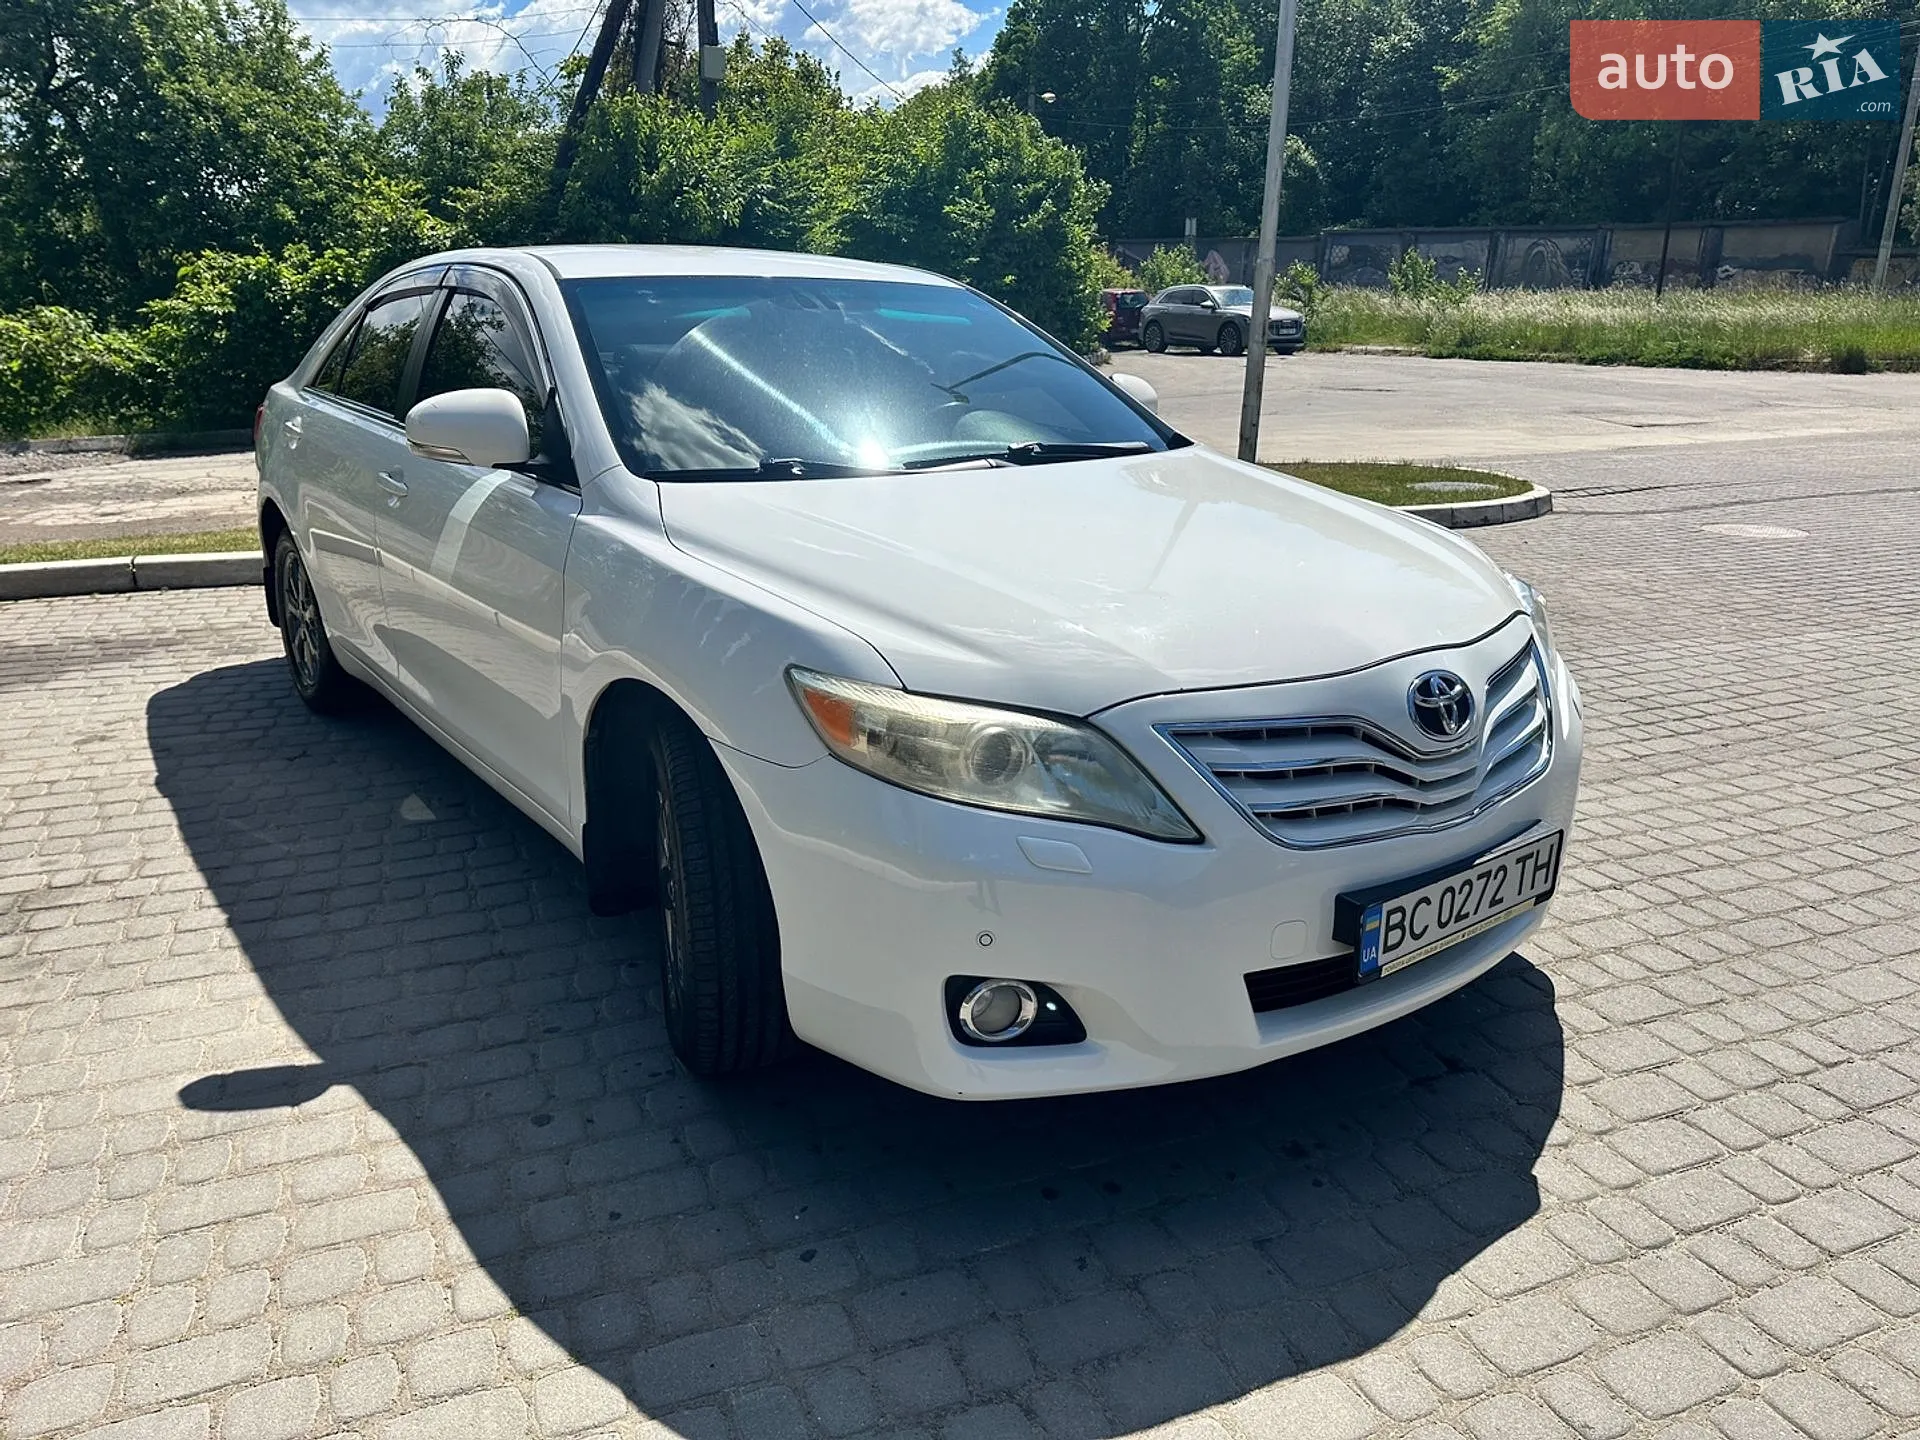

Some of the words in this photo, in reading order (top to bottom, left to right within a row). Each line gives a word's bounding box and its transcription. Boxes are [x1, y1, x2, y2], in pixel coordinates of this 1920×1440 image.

[1383, 895, 1432, 954] BC
[1437, 864, 1508, 930] 0272
[1516, 844, 1555, 896] TH
[1362, 945, 1377, 963] UA
